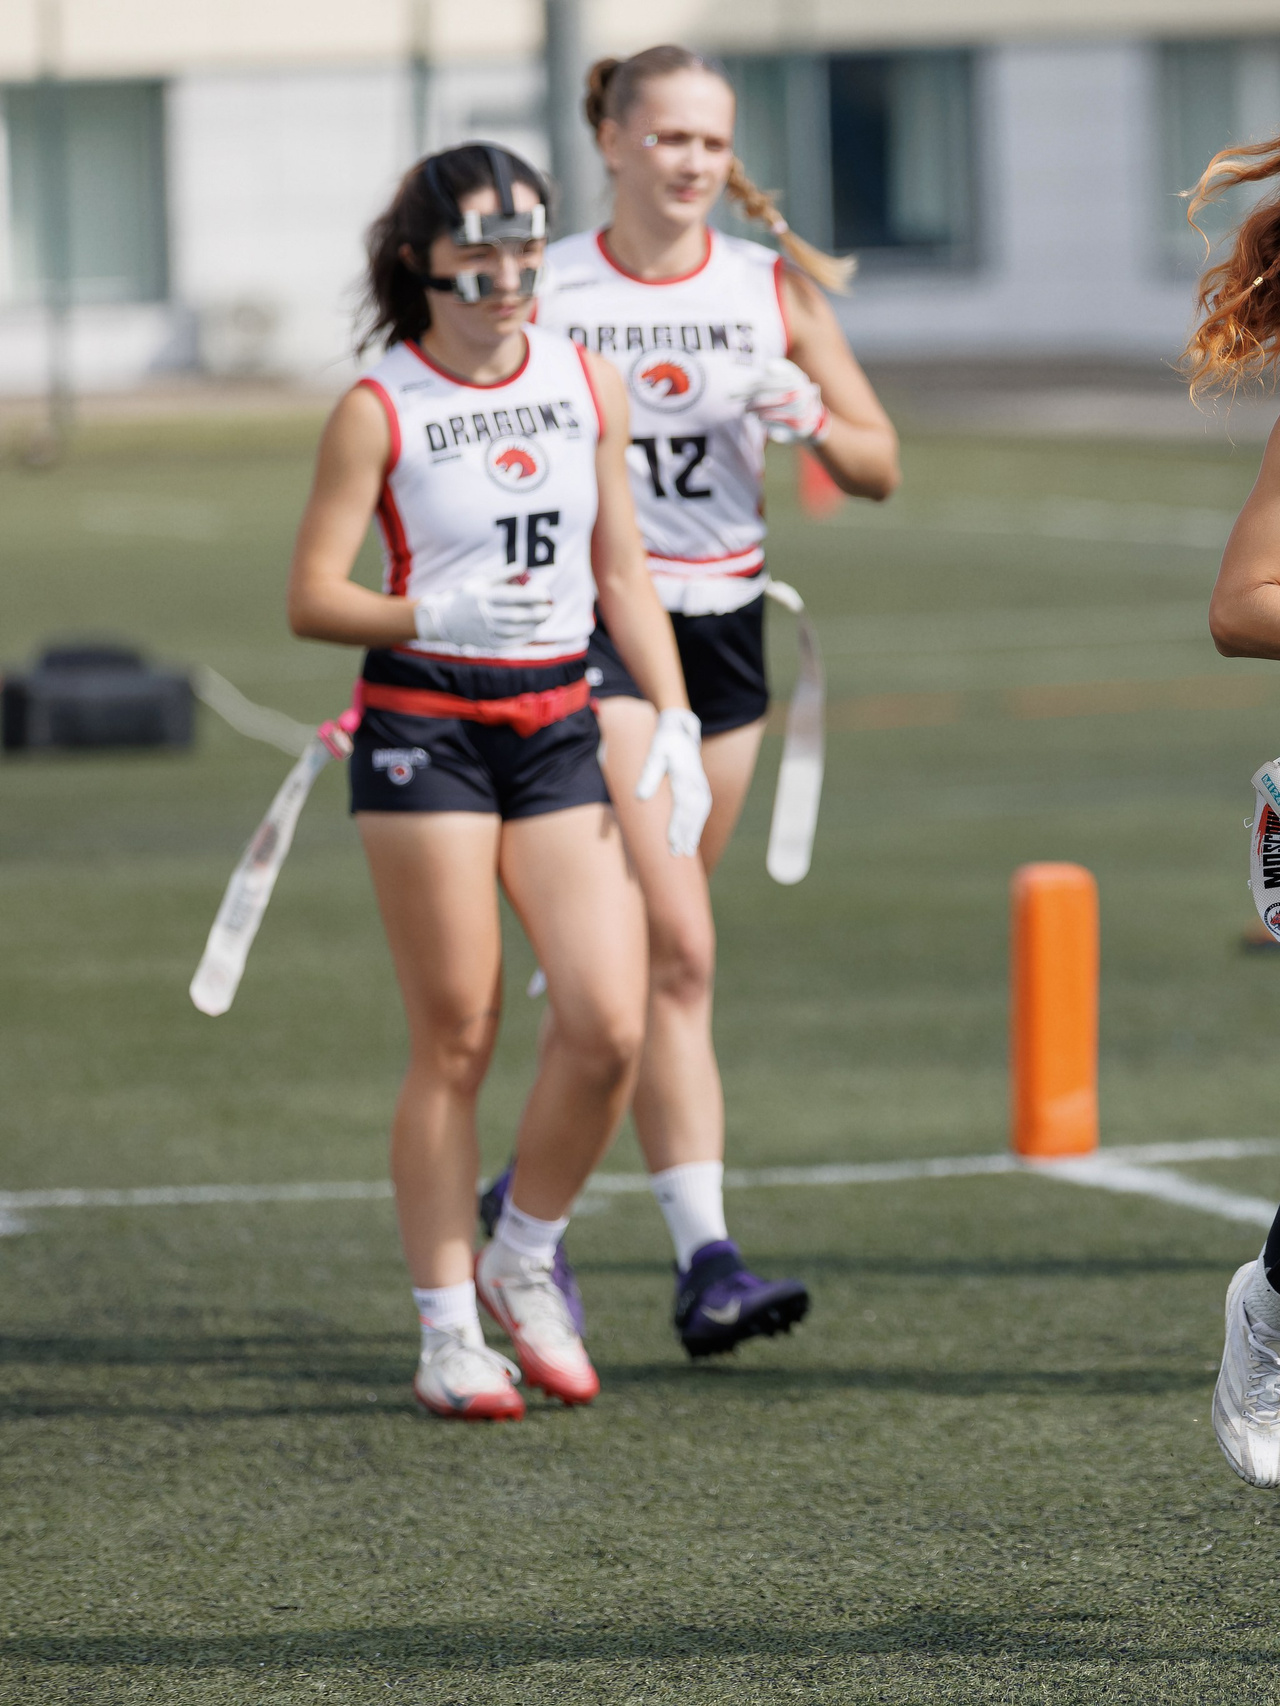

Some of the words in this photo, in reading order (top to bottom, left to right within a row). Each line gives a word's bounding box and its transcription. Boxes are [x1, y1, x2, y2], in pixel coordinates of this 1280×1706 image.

[568, 325, 754, 353] DRAGONS
[425, 400, 579, 452] DRAGONS
[632, 433, 712, 497] 12
[496, 511, 560, 567] 16
